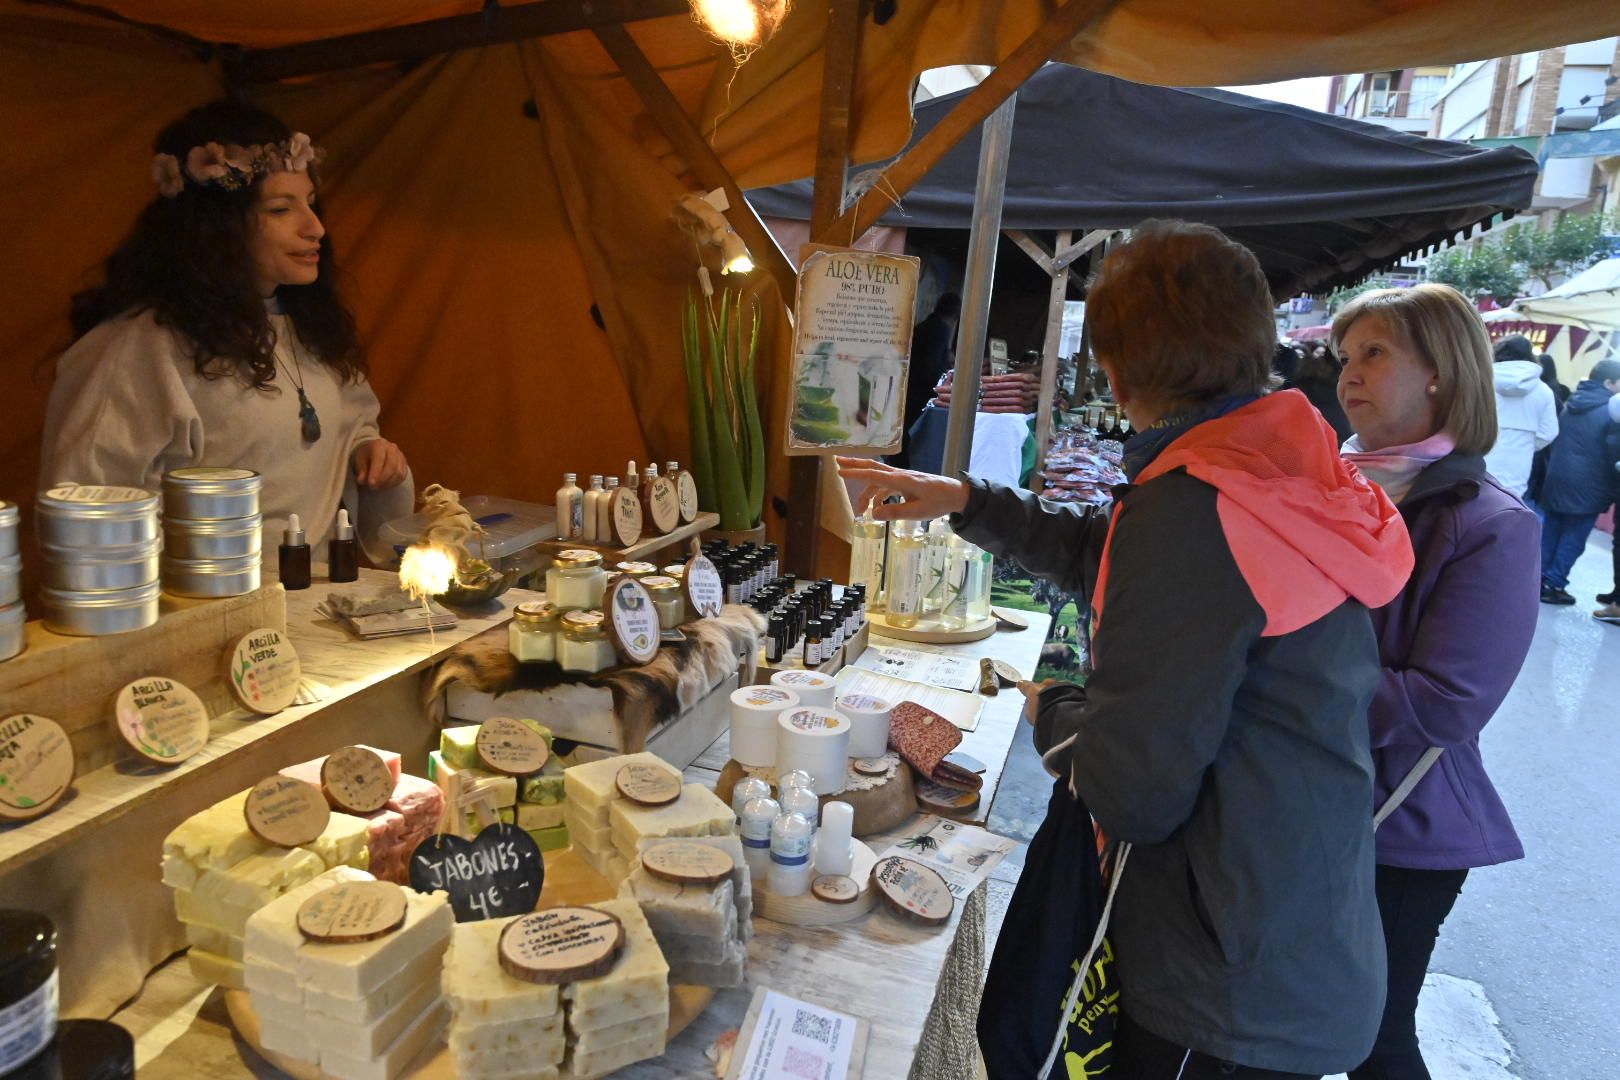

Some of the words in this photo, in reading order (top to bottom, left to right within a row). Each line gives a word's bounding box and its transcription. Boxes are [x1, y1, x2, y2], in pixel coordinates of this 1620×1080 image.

[826, 260, 862, 281] ALOE
[866, 264, 900, 285] VERA
[858, 284, 885, 295] PURO
[249, 647, 278, 663] VERDE
[429, 842, 519, 889] JABONES
